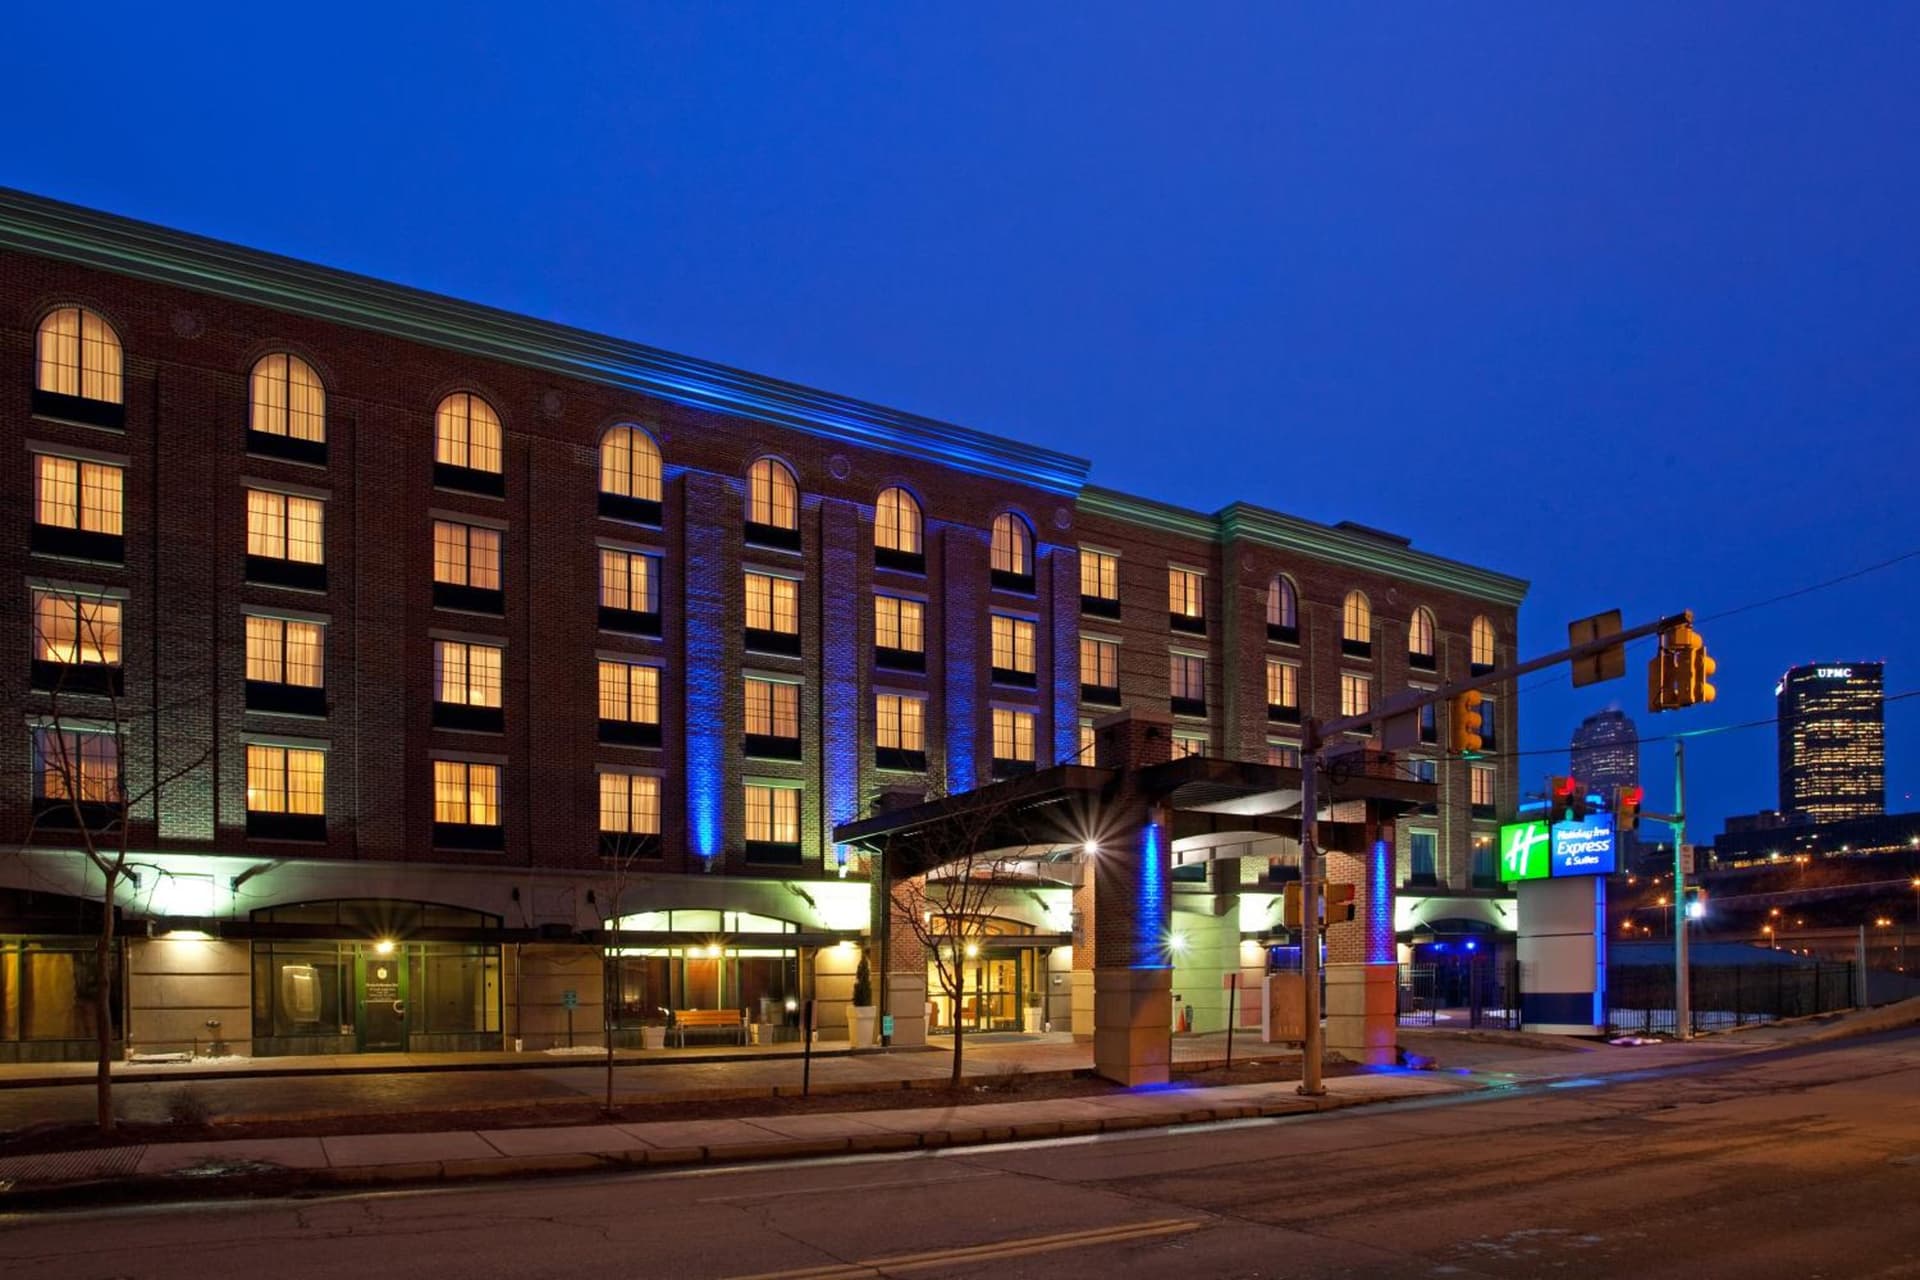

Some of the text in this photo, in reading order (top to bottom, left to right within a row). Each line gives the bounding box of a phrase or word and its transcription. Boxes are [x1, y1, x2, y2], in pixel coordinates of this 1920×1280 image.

[1818, 668, 1852, 678] UPMC
[1557, 826, 1610, 840] Holiday Inn
[1557, 840, 1611, 857] Express
[1565, 856, 1599, 866] & Suites
